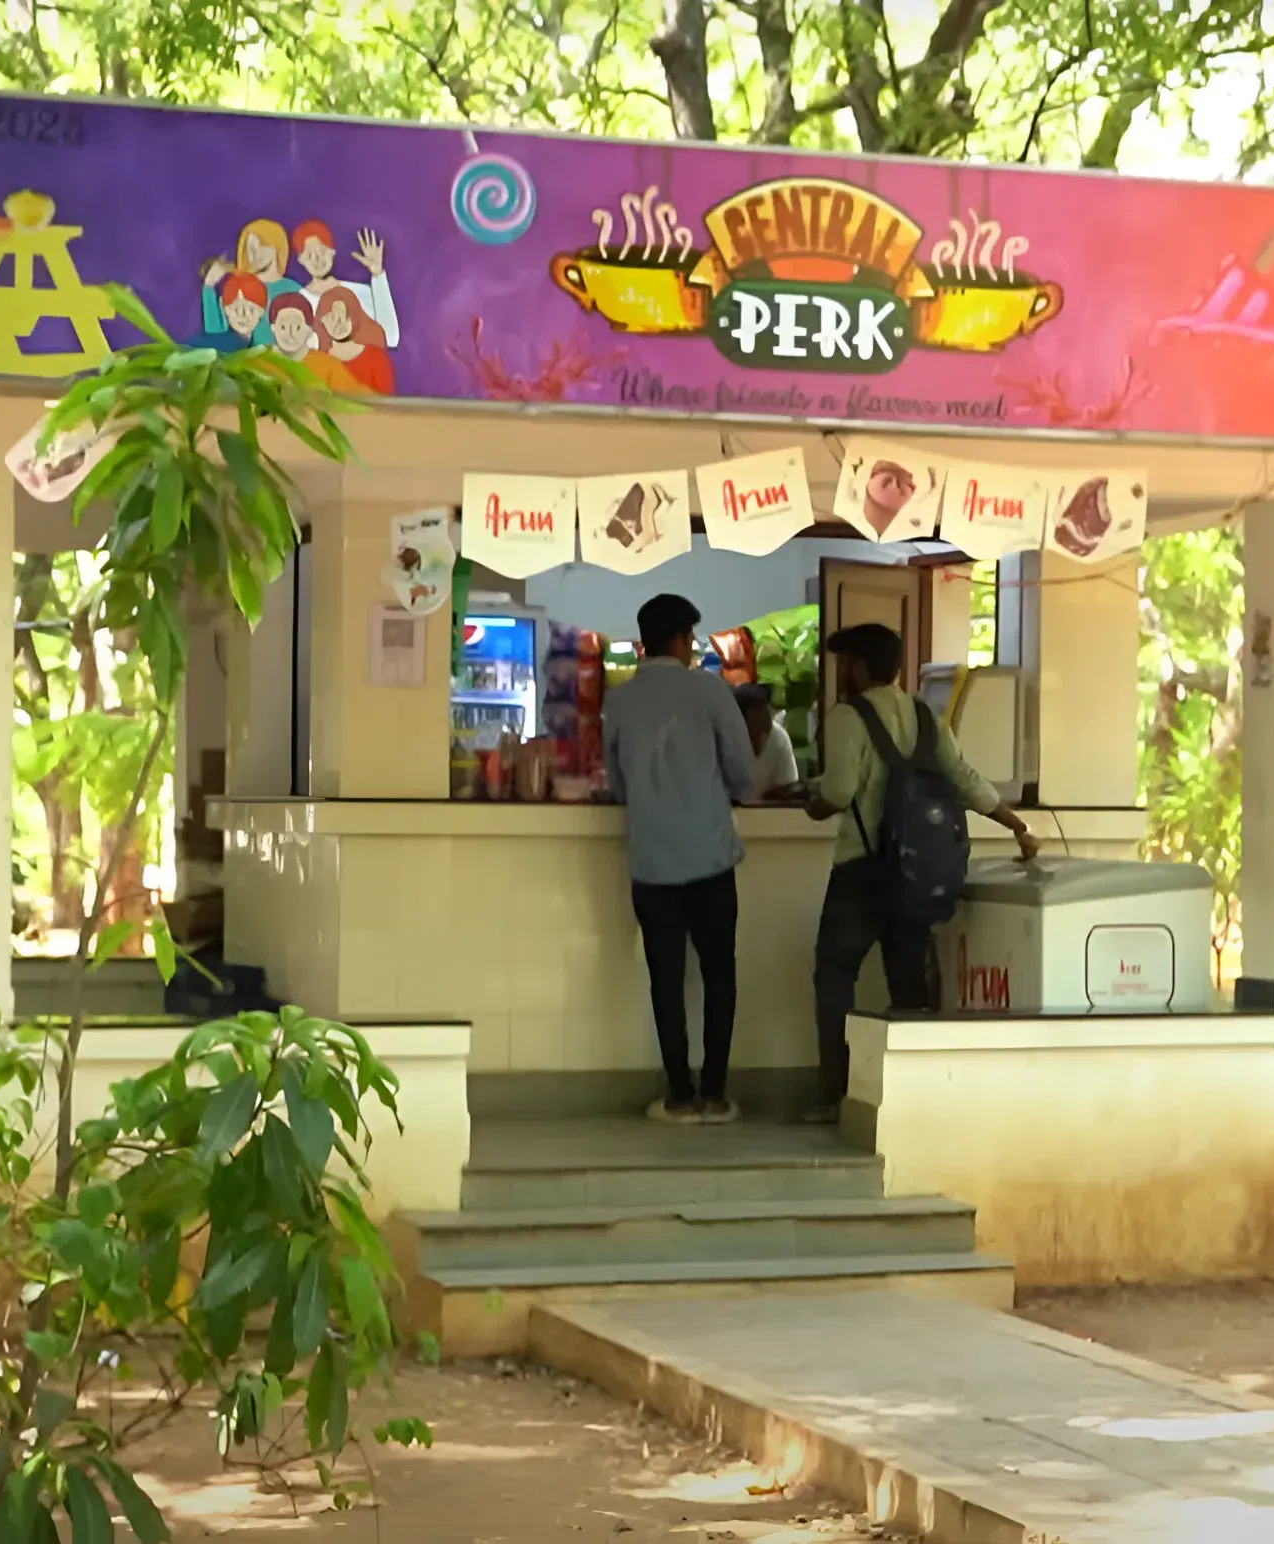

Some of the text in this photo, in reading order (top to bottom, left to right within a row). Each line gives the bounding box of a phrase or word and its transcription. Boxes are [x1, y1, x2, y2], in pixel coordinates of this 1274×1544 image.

[723, 185, 901, 267] CENTRAL
[731, 291, 896, 361] PERK
[485, 492, 553, 538] Arun
[722, 479, 789, 521] Arun
[962, 478, 1024, 522] Arun
